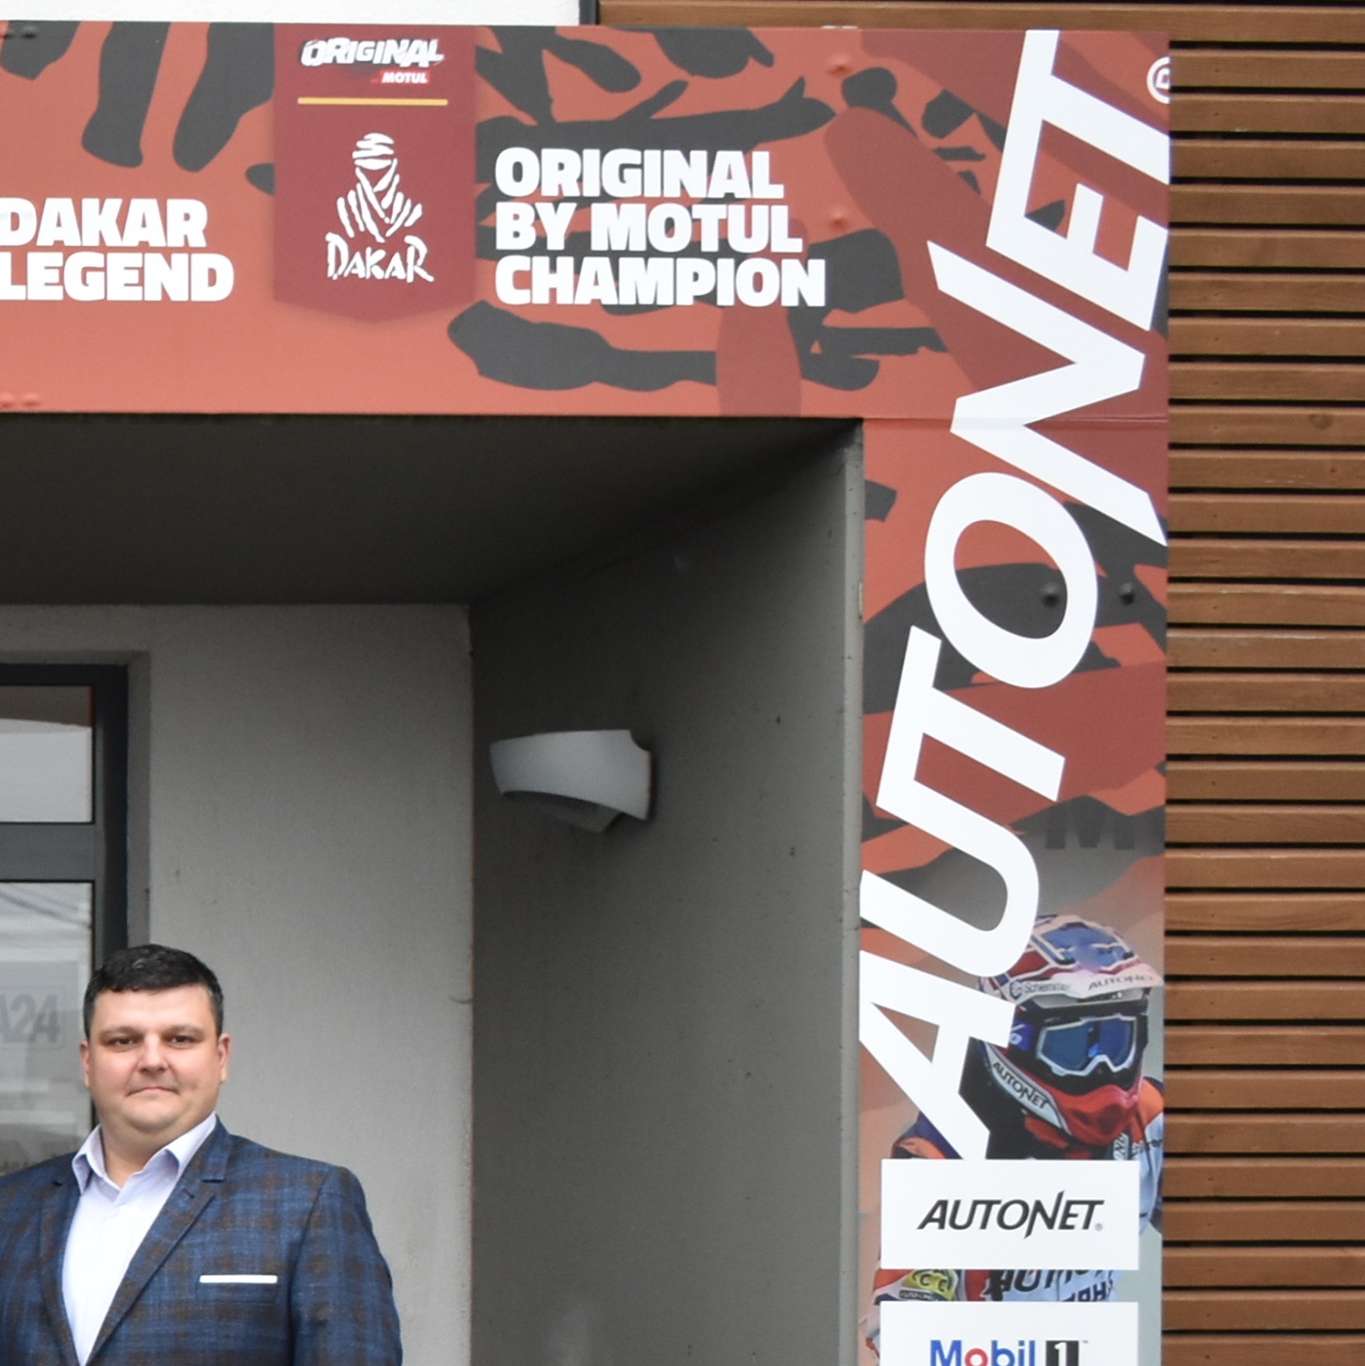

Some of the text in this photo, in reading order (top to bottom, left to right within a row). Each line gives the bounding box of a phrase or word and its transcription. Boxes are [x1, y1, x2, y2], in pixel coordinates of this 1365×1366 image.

[300, 36, 445, 69] ORIGINAL
[381, 71, 429, 84] MOTUL
[495, 147, 785, 199] ORIGINAL
[495, 202, 803, 253] BY MOTUL
[325, 232, 435, 284] DAKAR
[495, 255, 826, 307] CHAMPION
[859, 30, 1170, 1158] AUTONET
[991, 1061, 1048, 1109] AUTONET
[917, 1190, 1105, 1239] AUTONET
